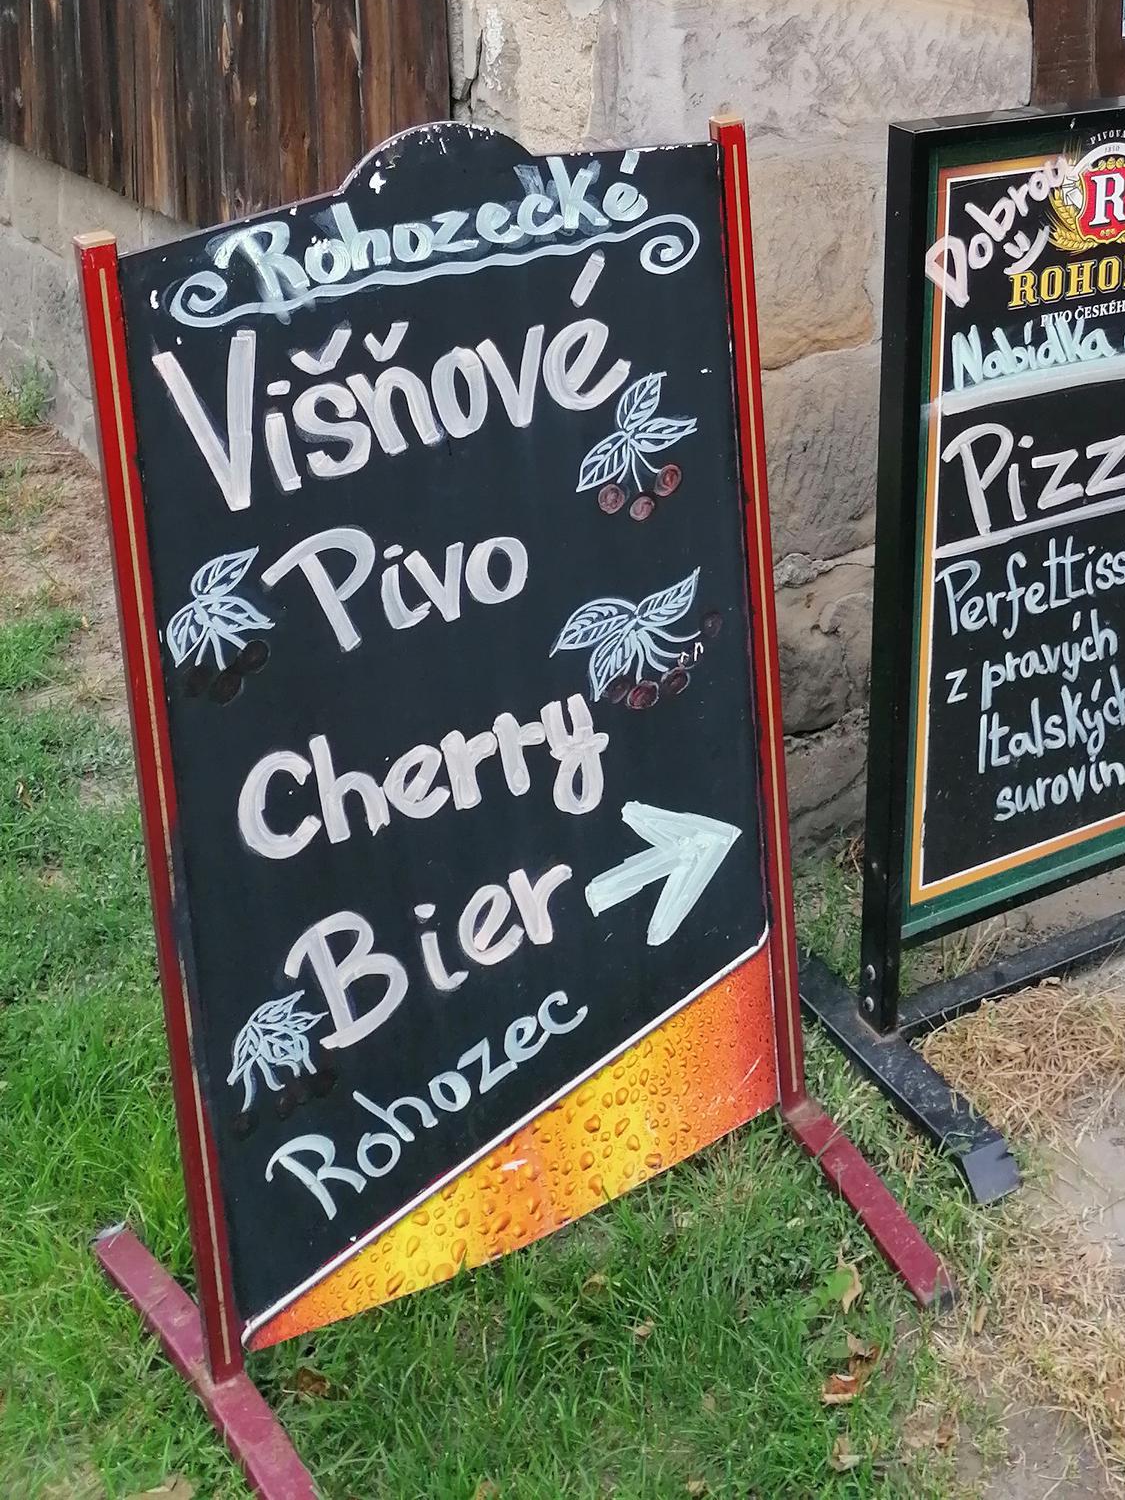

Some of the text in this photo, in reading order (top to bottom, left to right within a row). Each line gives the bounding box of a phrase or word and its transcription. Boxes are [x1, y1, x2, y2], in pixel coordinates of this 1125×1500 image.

[212, 150, 648, 312] Rohozecké
[152, 250, 631, 513] Višňové
[1040, 310, 1073, 328] PIVO
[261, 524, 529, 652] Pivo
[944, 608, 1118, 711] z pravých
[238, 693, 609, 860] Cherry
[284, 863, 573, 1050] Bier
[265, 989, 589, 1221] Rohozec
